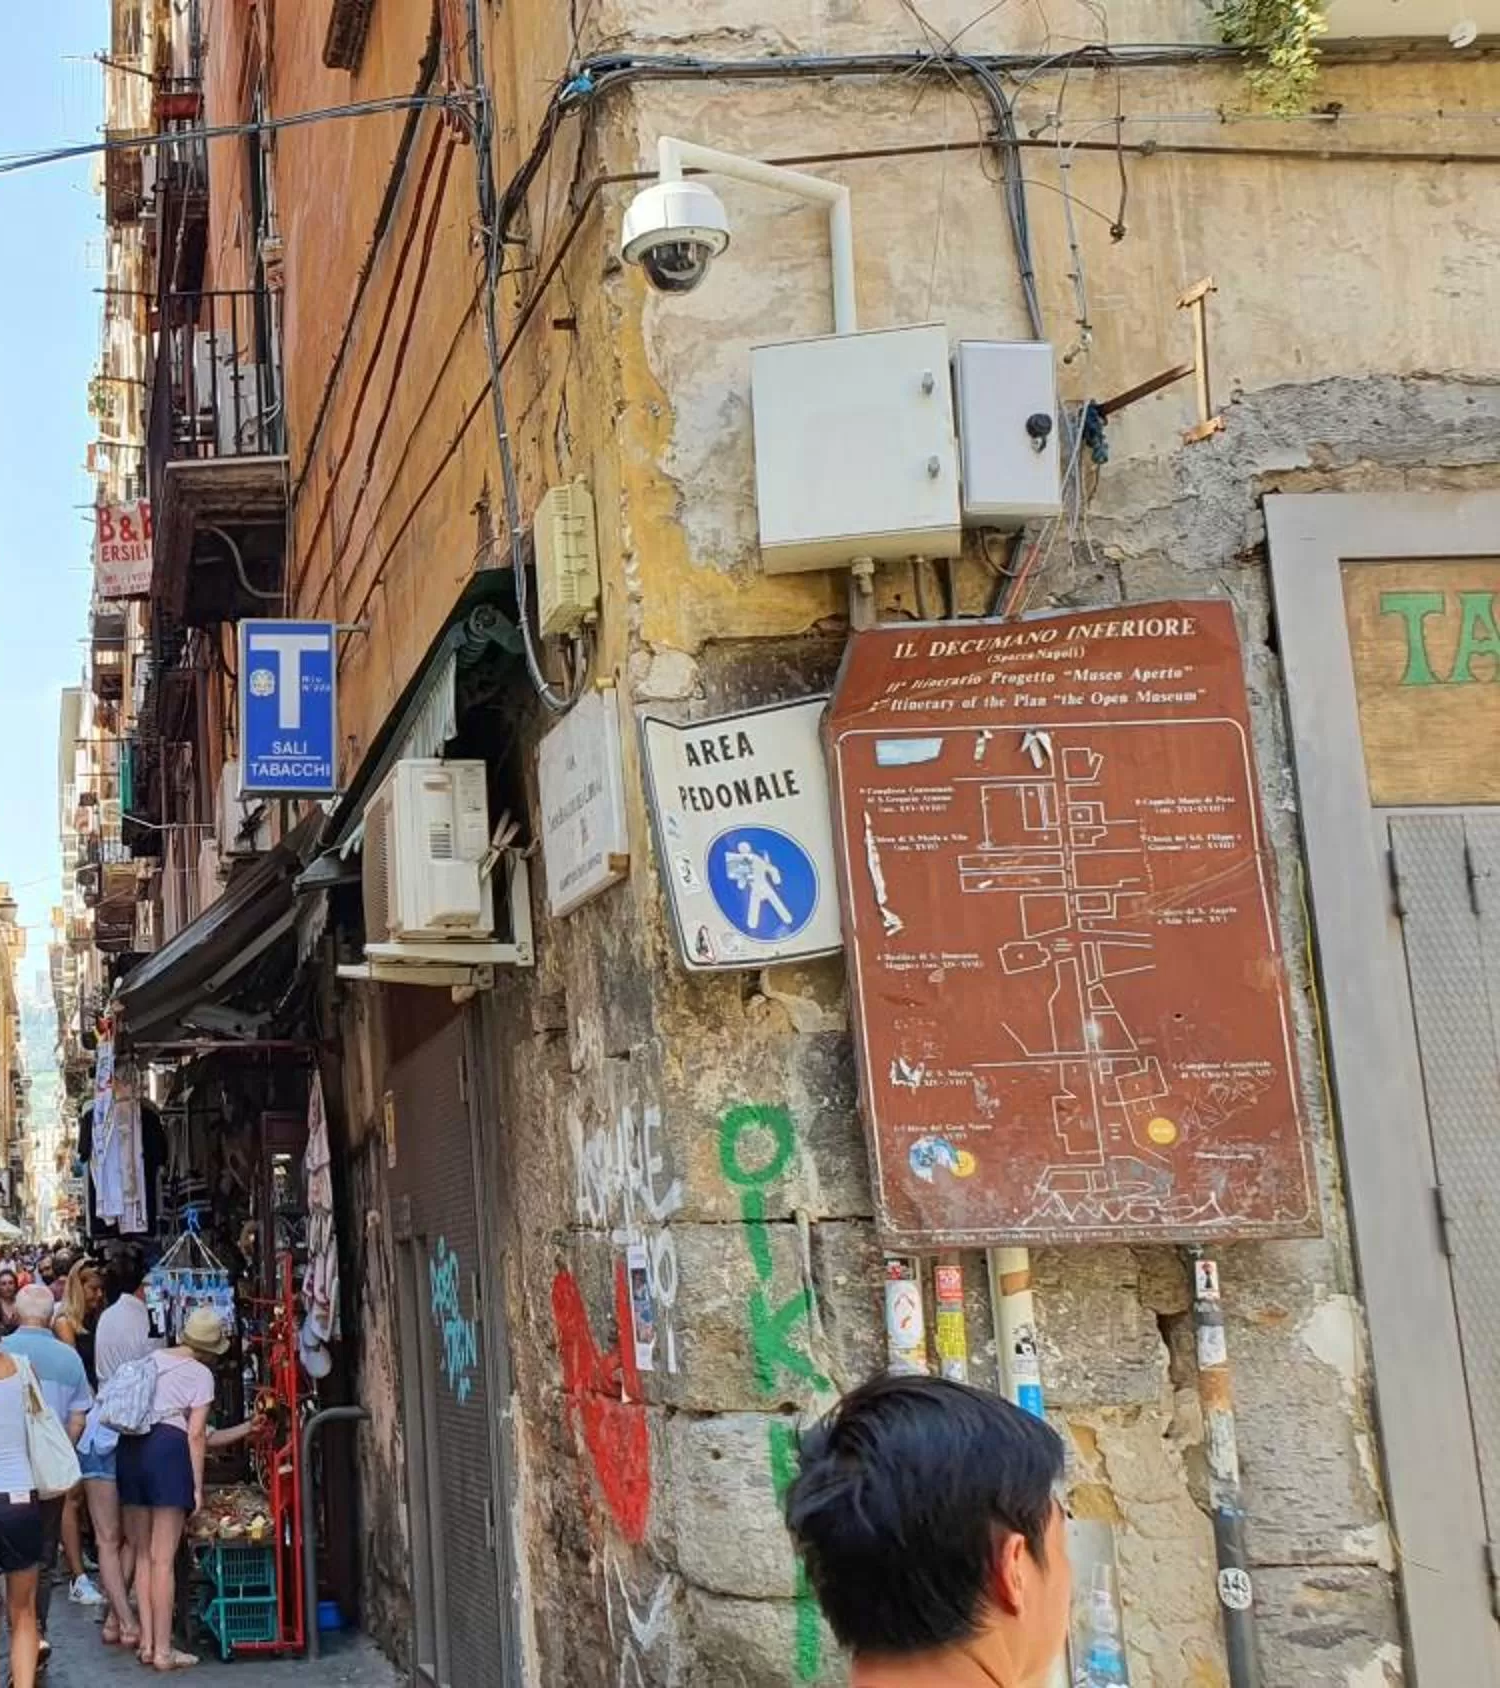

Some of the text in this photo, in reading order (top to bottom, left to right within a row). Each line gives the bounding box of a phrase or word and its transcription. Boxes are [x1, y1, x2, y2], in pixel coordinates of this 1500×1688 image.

[892, 617, 1197, 660] IL DECUMANO INFERIORE
[250, 633, 329, 730] T
[911, 672, 982, 689] Itinerario
[990, 671, 1056, 686] Progetto
[890, 698, 955, 713] Itinerary
[961, 697, 979, 710] of
[983, 695, 1005, 709] the
[1013, 693, 1047, 708] Plan
[1090, 691, 1129, 707] Open
[272, 741, 308, 755] SALI
[684, 731, 755, 767] AREA
[250, 763, 331, 777] TABACCHI
[678, 769, 801, 812] PEDONALE
